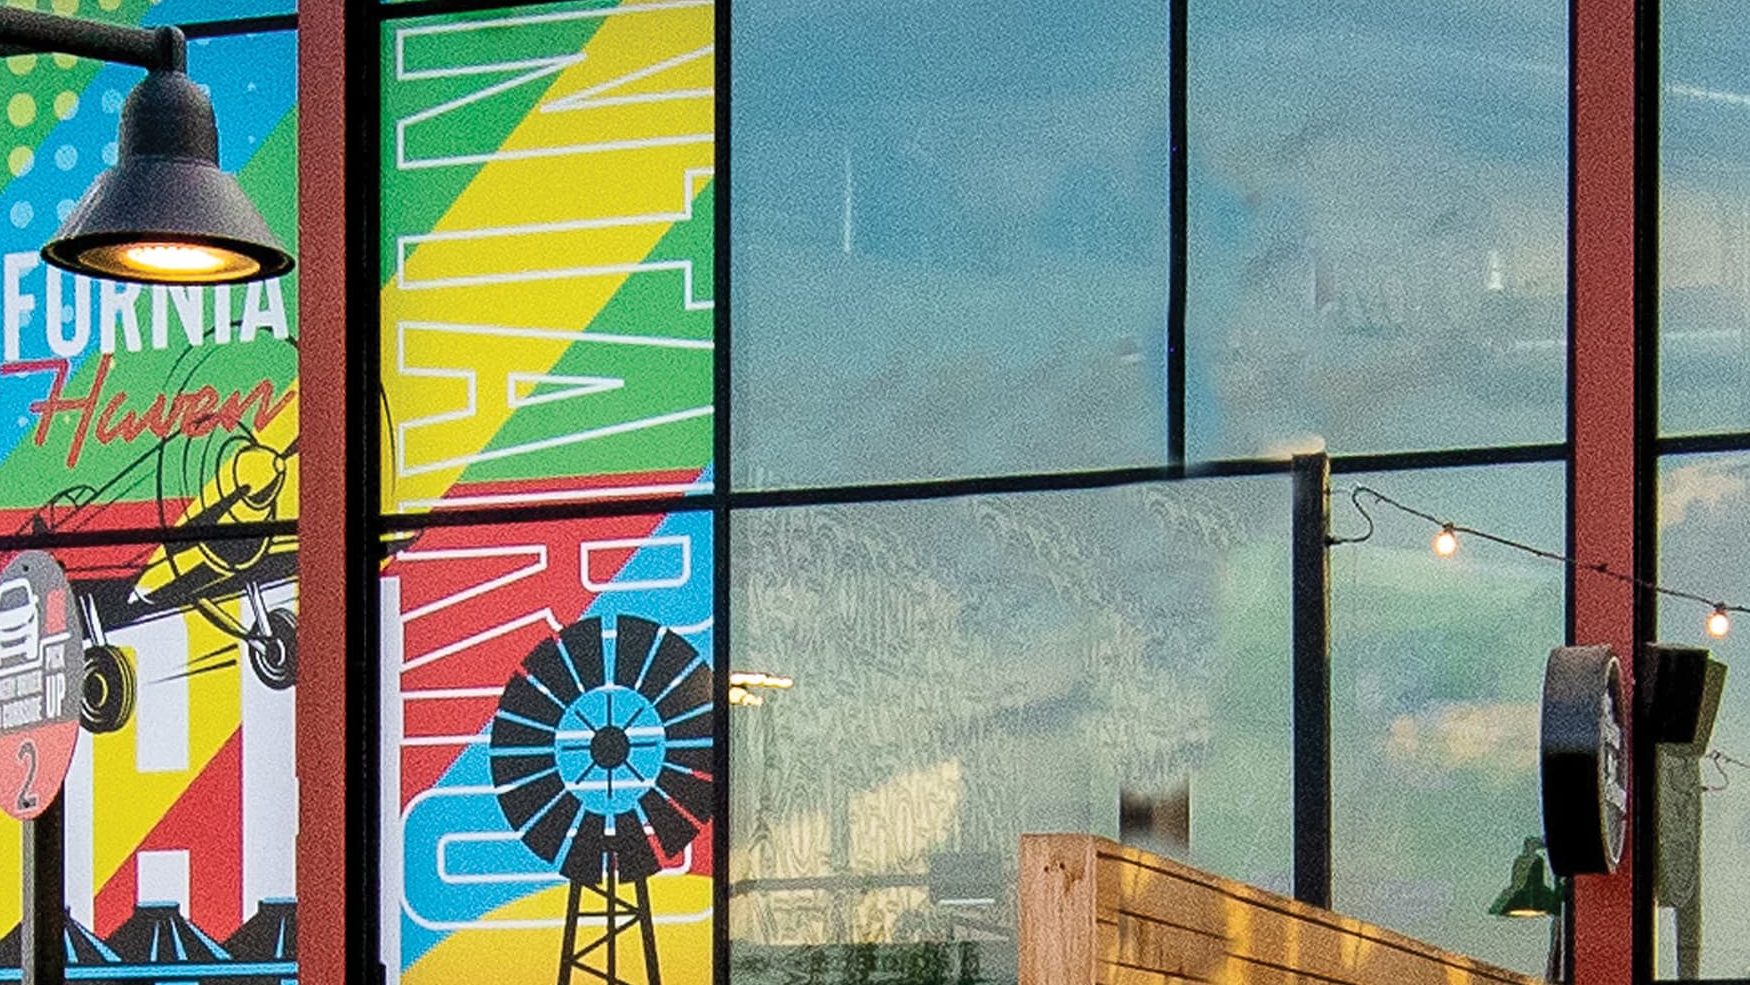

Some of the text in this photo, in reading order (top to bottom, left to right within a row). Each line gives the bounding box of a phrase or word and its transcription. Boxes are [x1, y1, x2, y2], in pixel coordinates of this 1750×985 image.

[0, 352, 299, 469] Haven
[45, 672, 66, 718] UP
[17, 741, 38, 810] 2
